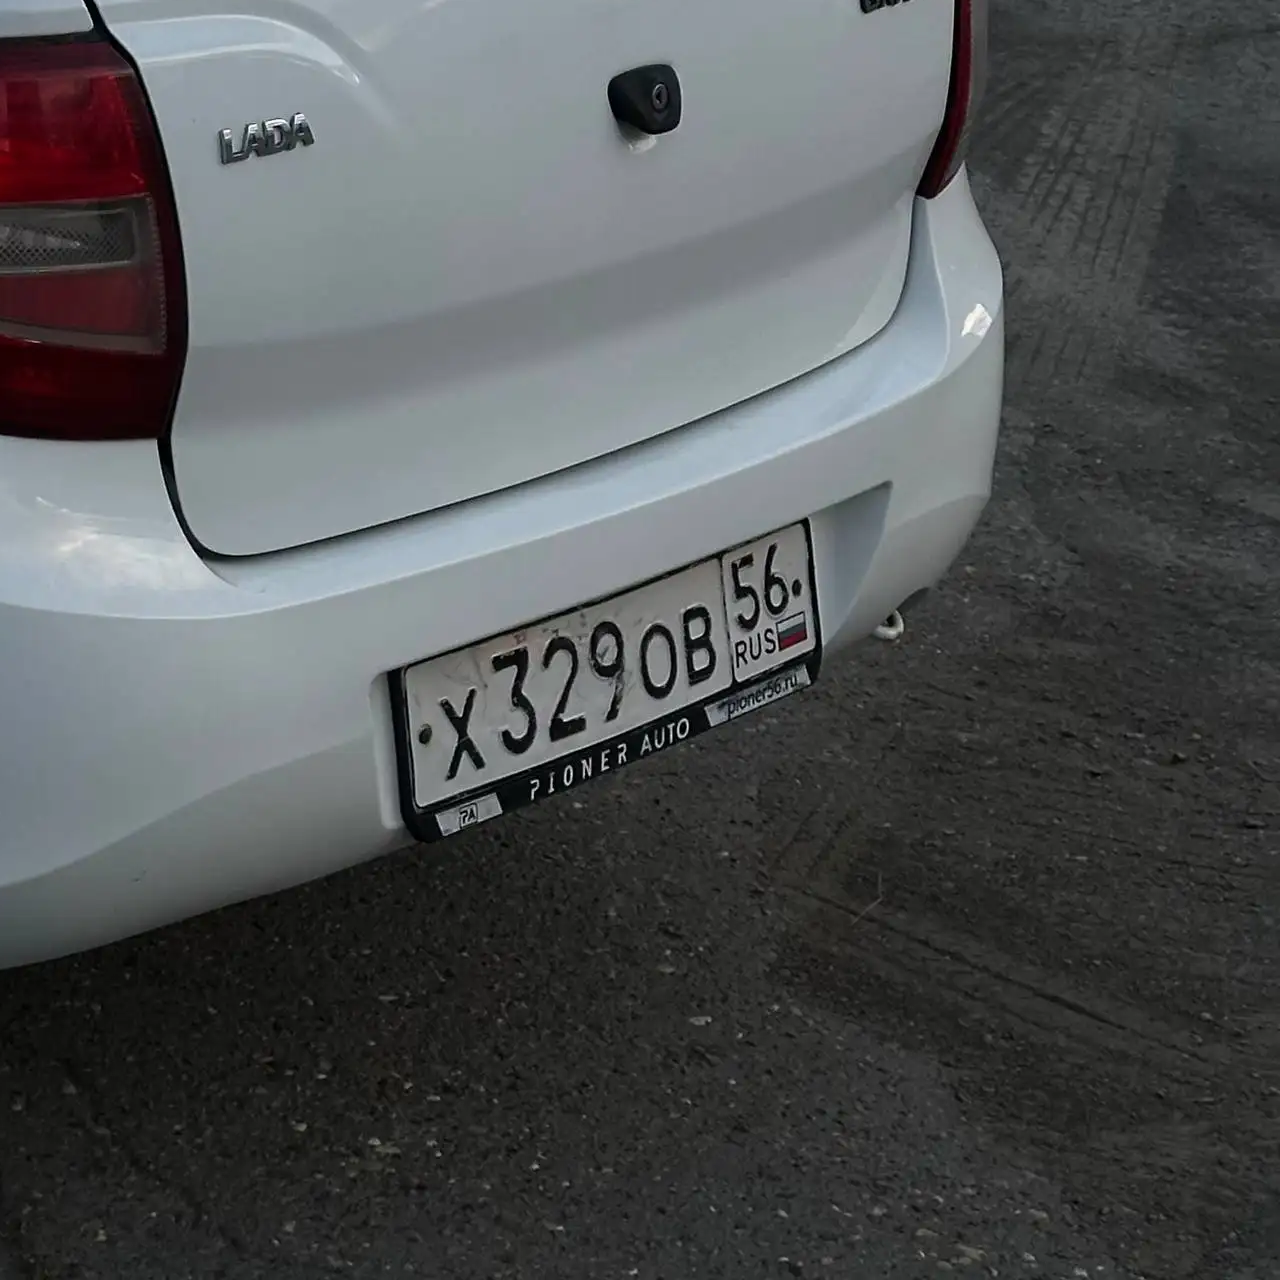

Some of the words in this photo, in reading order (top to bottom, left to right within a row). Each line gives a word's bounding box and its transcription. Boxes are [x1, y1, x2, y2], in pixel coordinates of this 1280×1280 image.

[219, 112, 315, 165] LADA
[734, 630, 777, 670] RUS
[727, 673, 799, 721] pioner56.ru
[530, 743, 628, 801] PIONER
[640, 718, 690, 756] AUTO
